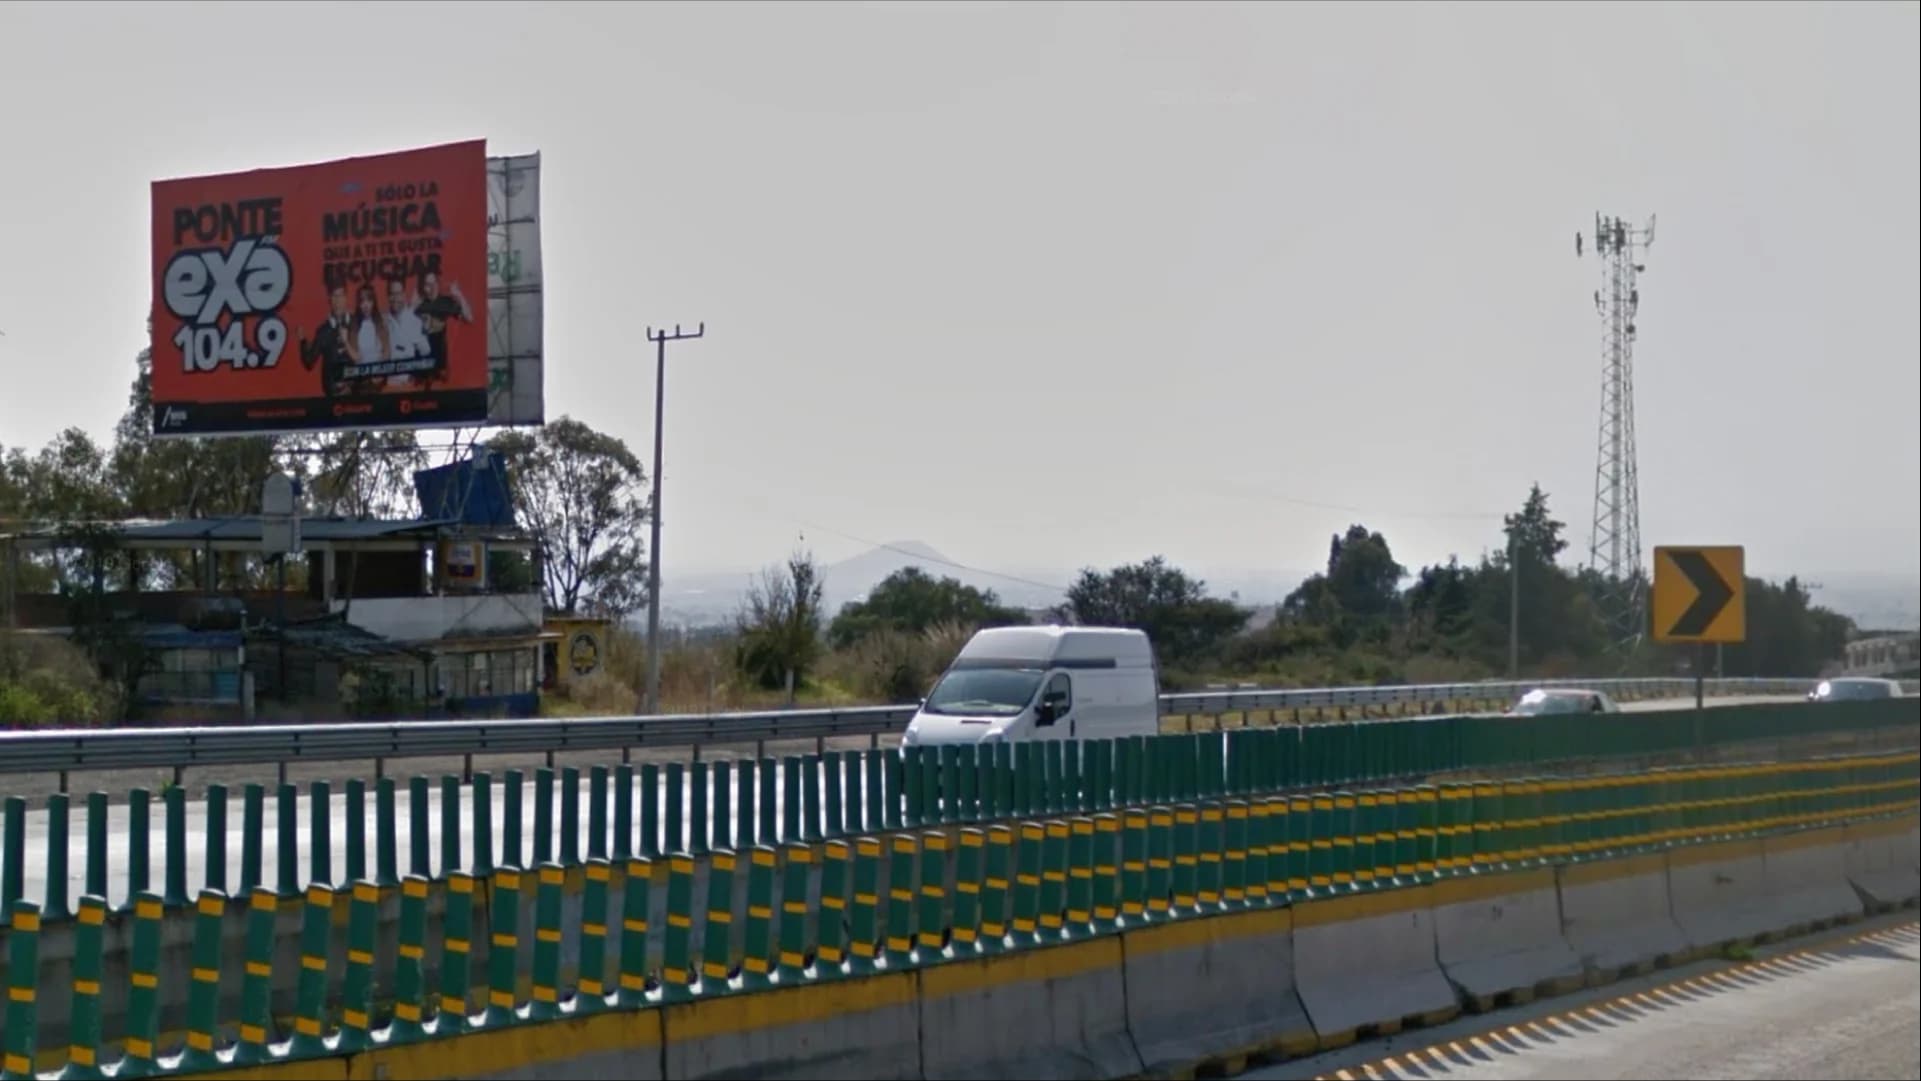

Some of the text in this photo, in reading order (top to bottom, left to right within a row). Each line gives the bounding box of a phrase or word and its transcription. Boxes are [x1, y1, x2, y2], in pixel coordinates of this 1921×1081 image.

[376, 181, 438, 202] SÓLO LA
[173, 197, 283, 244] PONTE
[323, 202, 442, 242] MÚSICA
[324, 238, 442, 260] QUE A TI TE GUSTA
[322, 253, 443, 286] ESCUCHAR
[173, 317, 287, 372] 104.9
